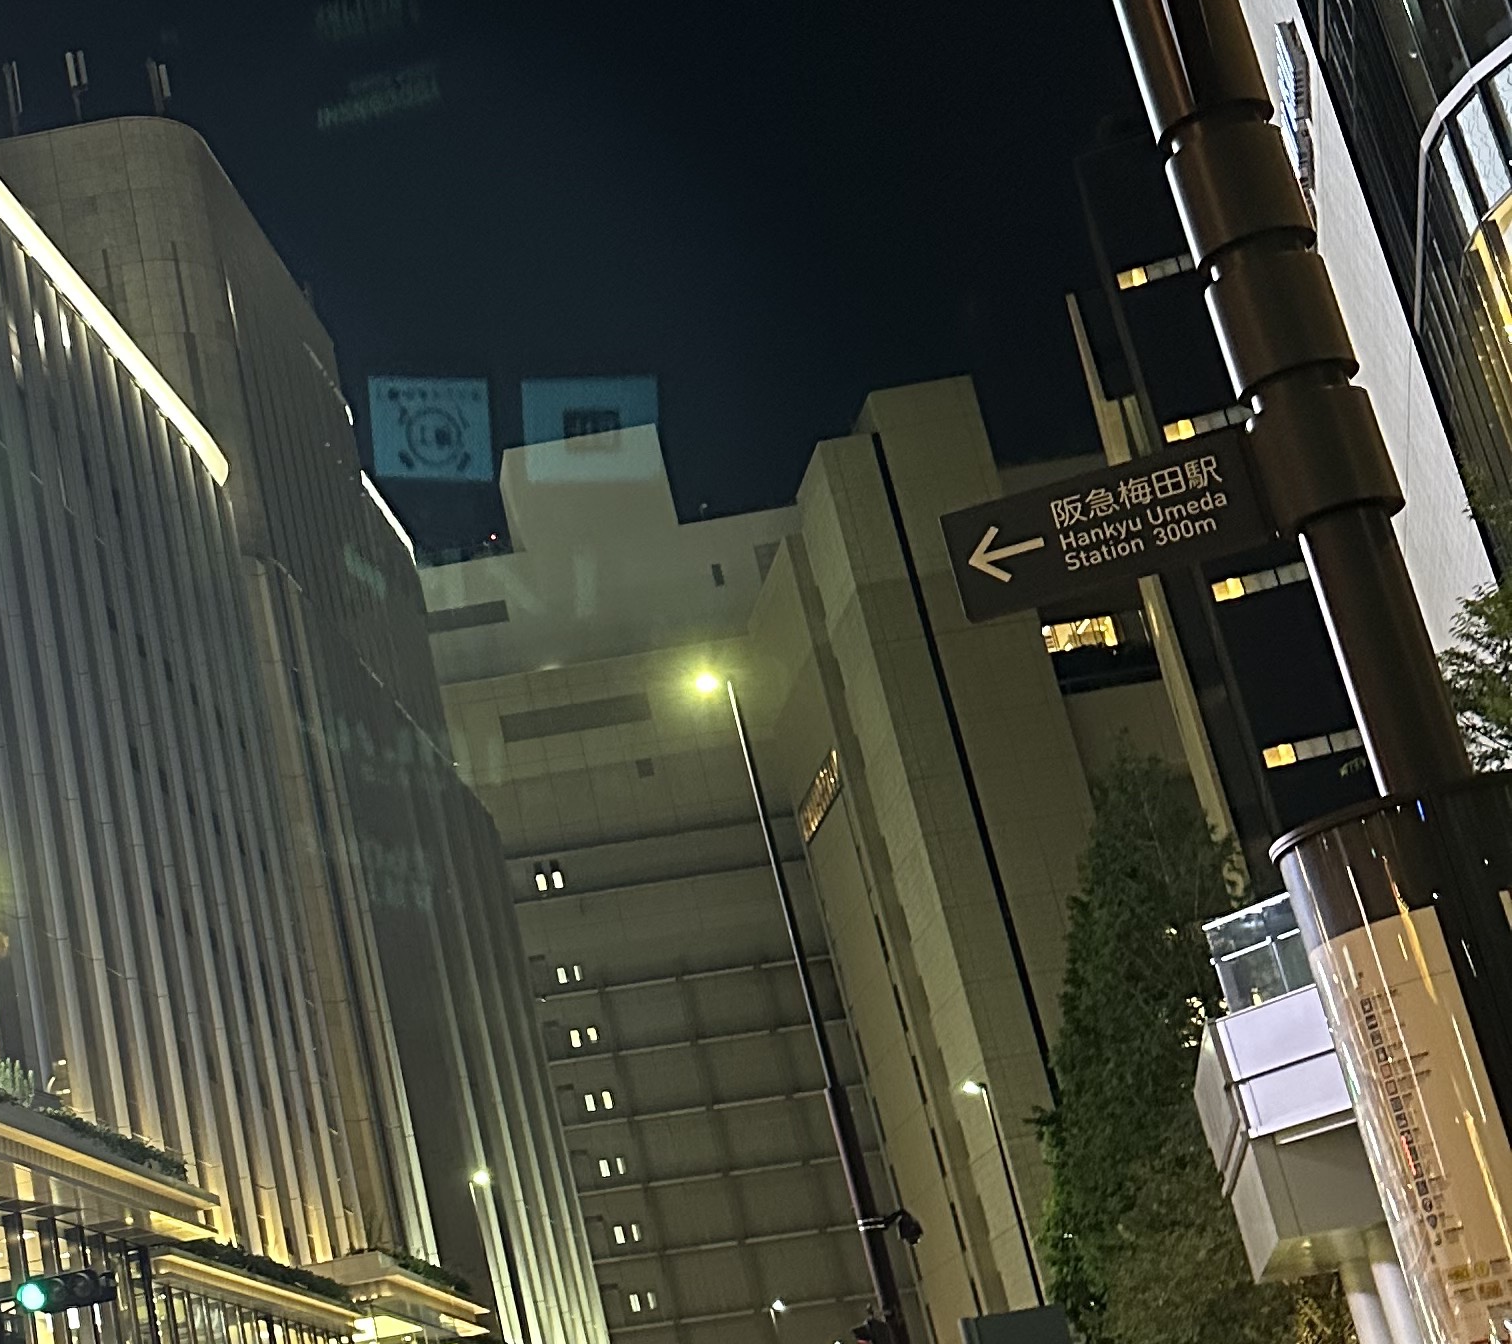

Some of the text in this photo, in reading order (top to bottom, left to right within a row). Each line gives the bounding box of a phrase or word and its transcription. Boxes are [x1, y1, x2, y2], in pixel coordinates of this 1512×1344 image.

[1050, 455, 1223, 530] 阪急梅田駅
[1059, 491, 1228, 551] Hankyu Umeda
[1064, 517, 1218, 571] Station 300m
